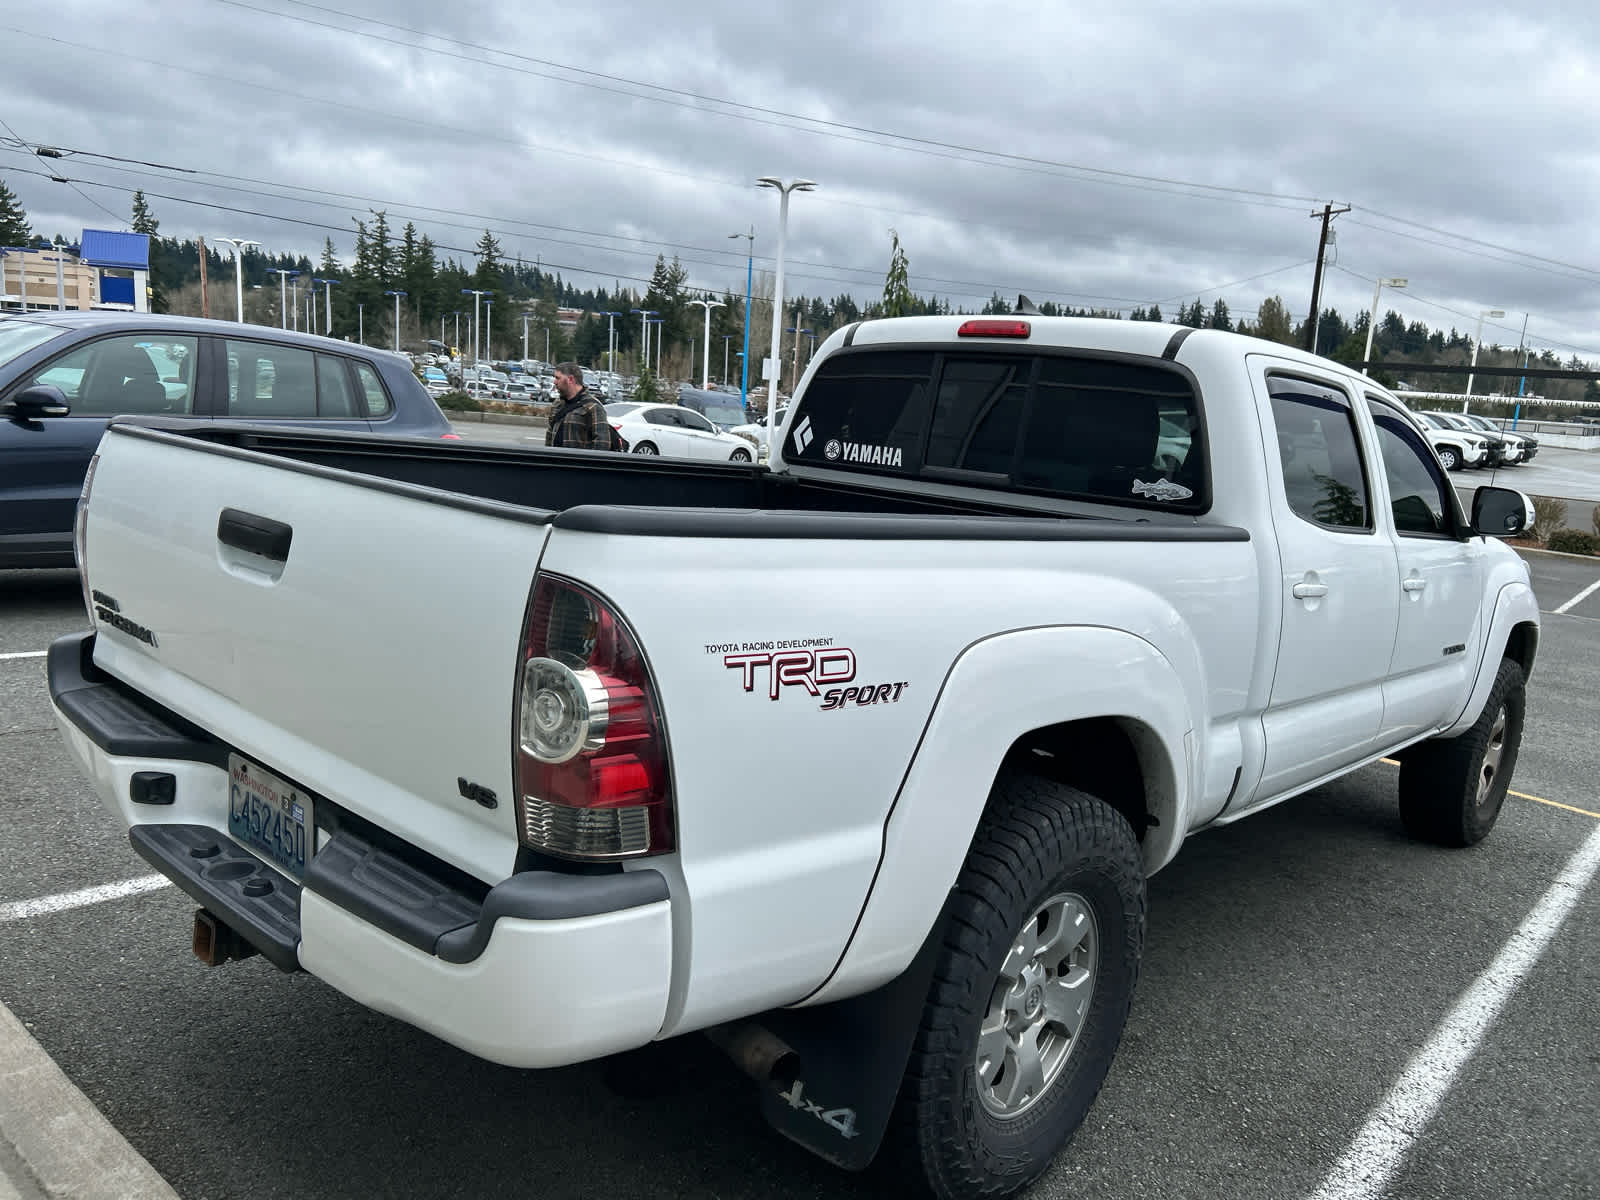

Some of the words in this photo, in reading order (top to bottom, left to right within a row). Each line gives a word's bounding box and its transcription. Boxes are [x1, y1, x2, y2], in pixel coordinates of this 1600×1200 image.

[843, 442, 902, 467] YAMAHA
[704, 643, 739, 654] TOYOTA
[742, 641, 775, 652] RACING
[777, 637, 834, 649] DEVELOPMENT
[724, 647, 857, 701] TRD
[819, 681, 908, 711] SPORT
[233, 767, 279, 806] WASHINGTON
[457, 776, 498, 810] V6
